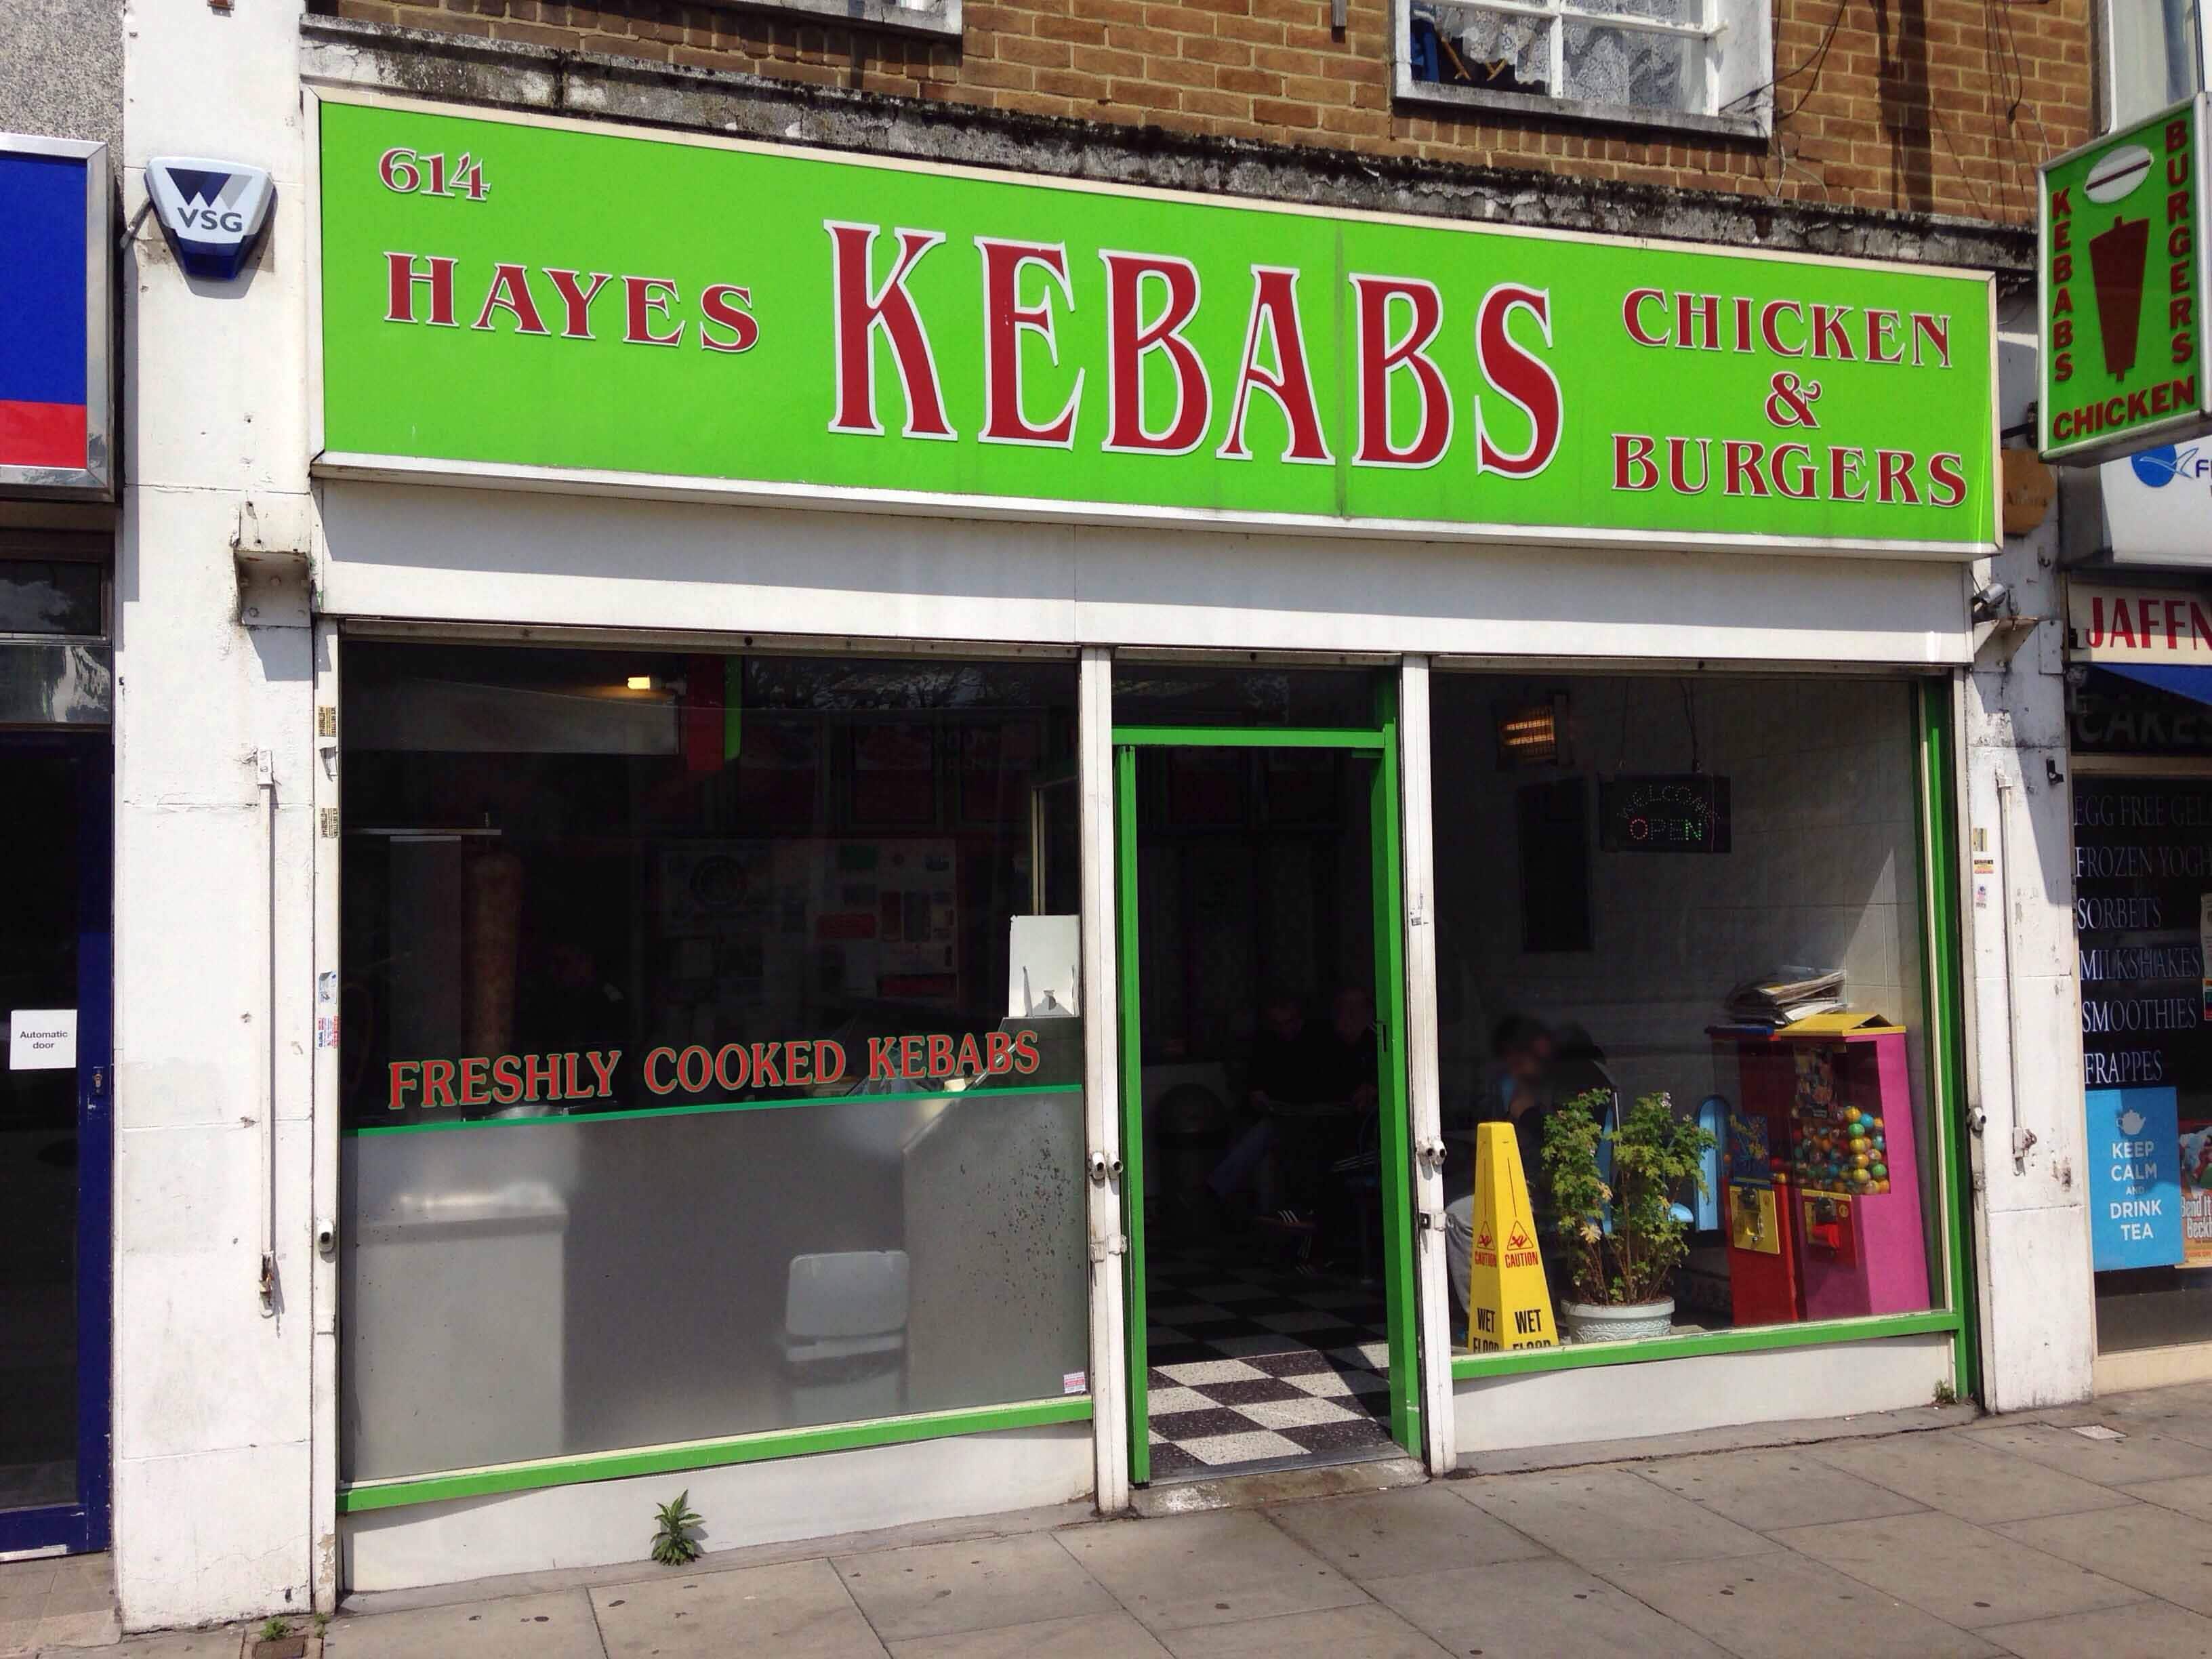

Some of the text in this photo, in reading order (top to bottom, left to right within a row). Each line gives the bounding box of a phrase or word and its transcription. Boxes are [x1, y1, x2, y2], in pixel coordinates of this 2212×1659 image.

[379, 148, 491, 201] 614
[178, 207, 242, 232] VSG
[2165, 120, 2193, 364] BURGERS
[2052, 187, 2074, 382] KEBABS
[384, 251, 760, 353] HAYES
[1622, 288, 1952, 368] CHICKEN
[824, 219, 1564, 481] KEBABS
[1765, 371, 1822, 428] &
[2053, 375, 2195, 441] CHICKEN
[1612, 434, 1967, 508] BURGERS
[1629, 818, 1703, 841] OPEN
[2075, 846, 2152, 878] FROZEN
[2077, 896, 2163, 929] SORBETS
[2080, 946, 2202, 981] MILKSHAKES
[2082, 998, 2196, 1033] SMOOTHIES
[20, 1030, 68, 1039] Automatic
[33, 1041, 55, 1049] door
[389, 1030, 1040, 1110] FRESHLY COOKED KEBABS
[2084, 1049, 2163, 1084] FRAPPES
[2112, 1141, 2155, 1160] KEEP
[2110, 1163, 2158, 1182] CALM
[2125, 1186, 2145, 1196] AND
[2110, 1200, 2163, 1219] DRINK
[2120, 1223, 2154, 1241] TEA
[1474, 1251, 1497, 1268] CAUTION
[1504, 1250, 1539, 1269] CAUTION
[1477, 1307, 1496, 1334] WET
[1515, 1309, 1542, 1334] WET
